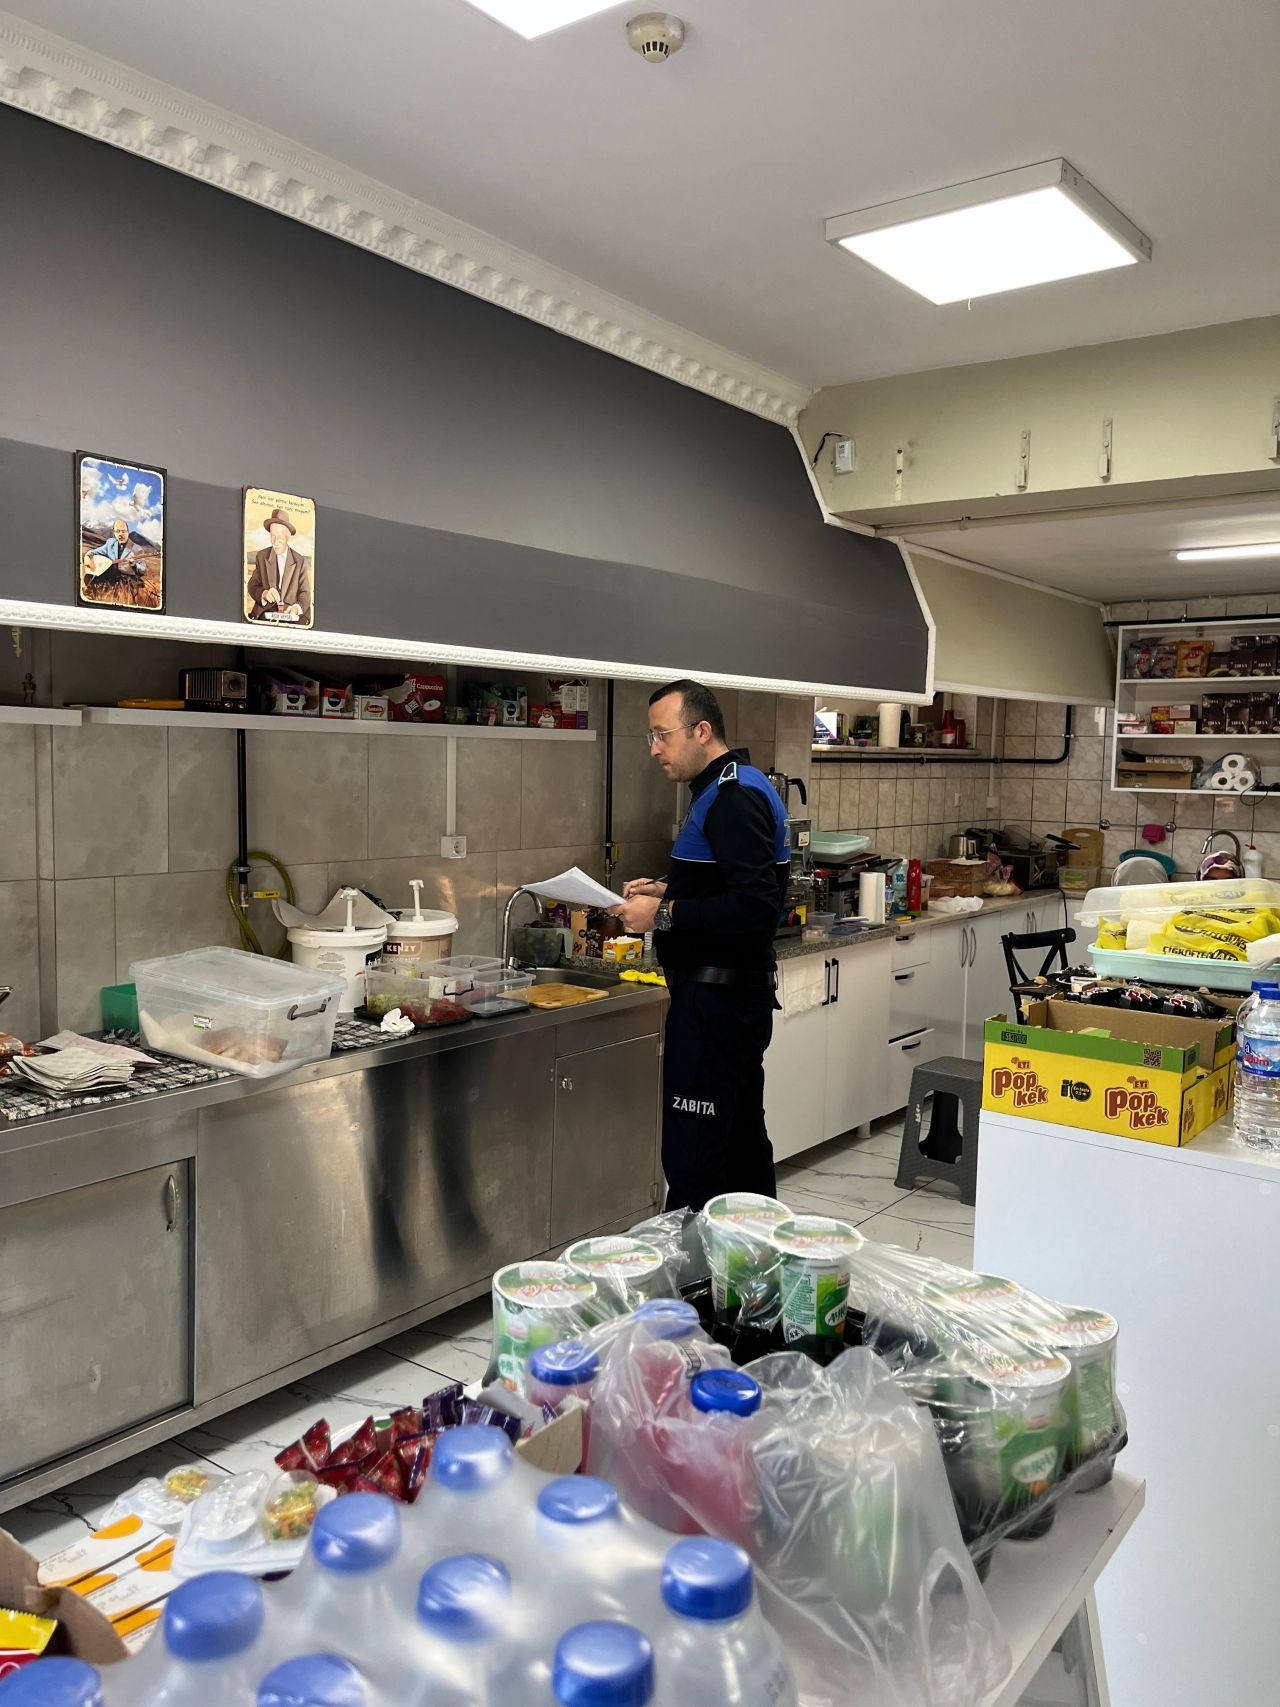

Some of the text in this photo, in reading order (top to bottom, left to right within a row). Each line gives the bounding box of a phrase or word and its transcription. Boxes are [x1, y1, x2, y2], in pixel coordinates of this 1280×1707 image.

[416, 683, 444, 691] Cappuccino
[386, 944, 416, 953] KENZY
[672, 1095, 716, 1116] ZABITA
[1014, 1085, 1048, 1108] kek
[1130, 1106, 1169, 1130] kek
